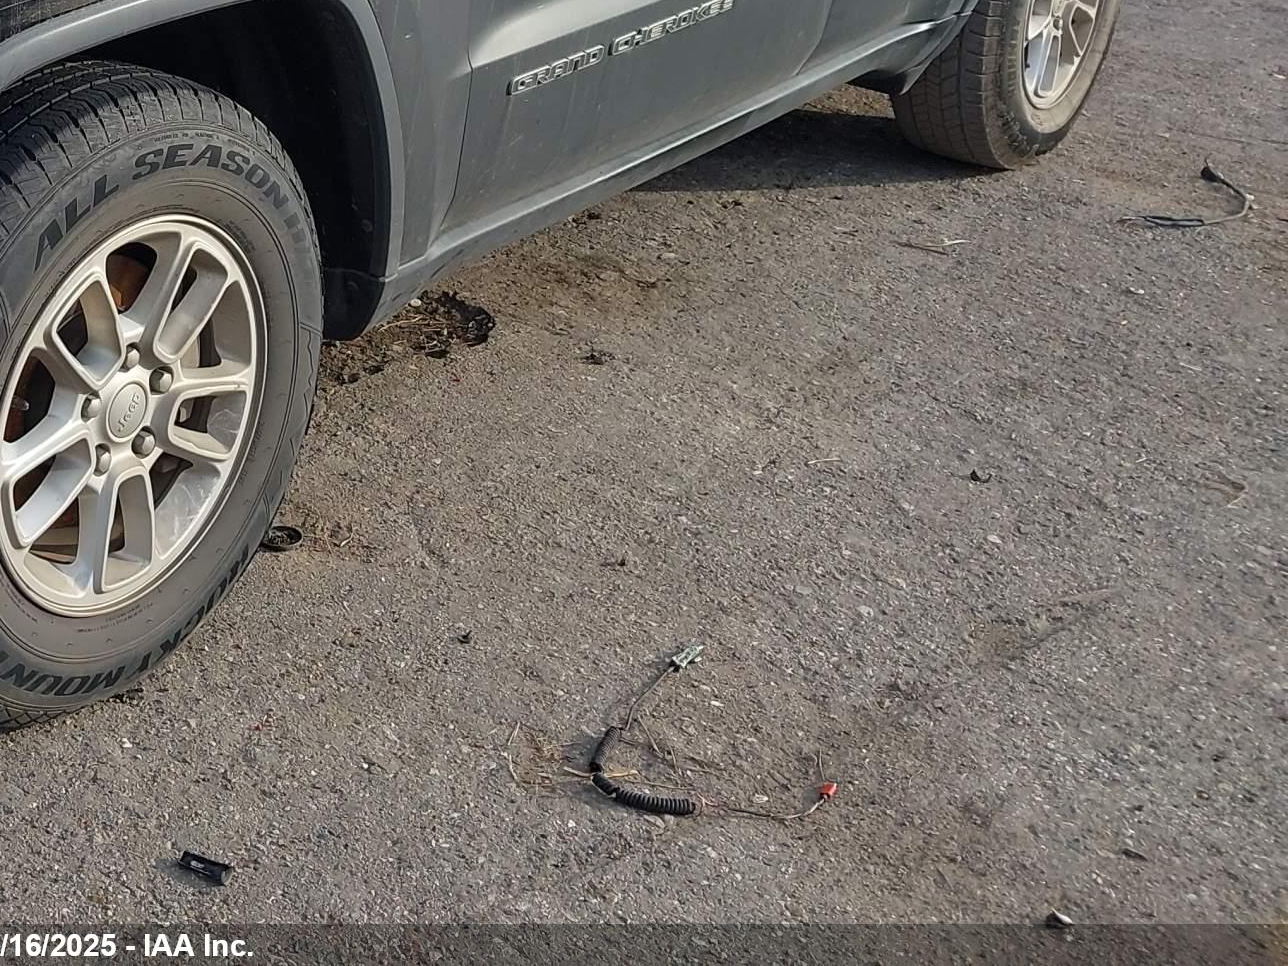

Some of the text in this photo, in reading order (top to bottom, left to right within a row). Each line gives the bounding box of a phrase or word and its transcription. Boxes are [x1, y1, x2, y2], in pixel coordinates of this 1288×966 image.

[510, 44, 605, 95] GRAND
[34, 143, 290, 274] ALL SEASON
[116, 392, 140, 433] Jeep
